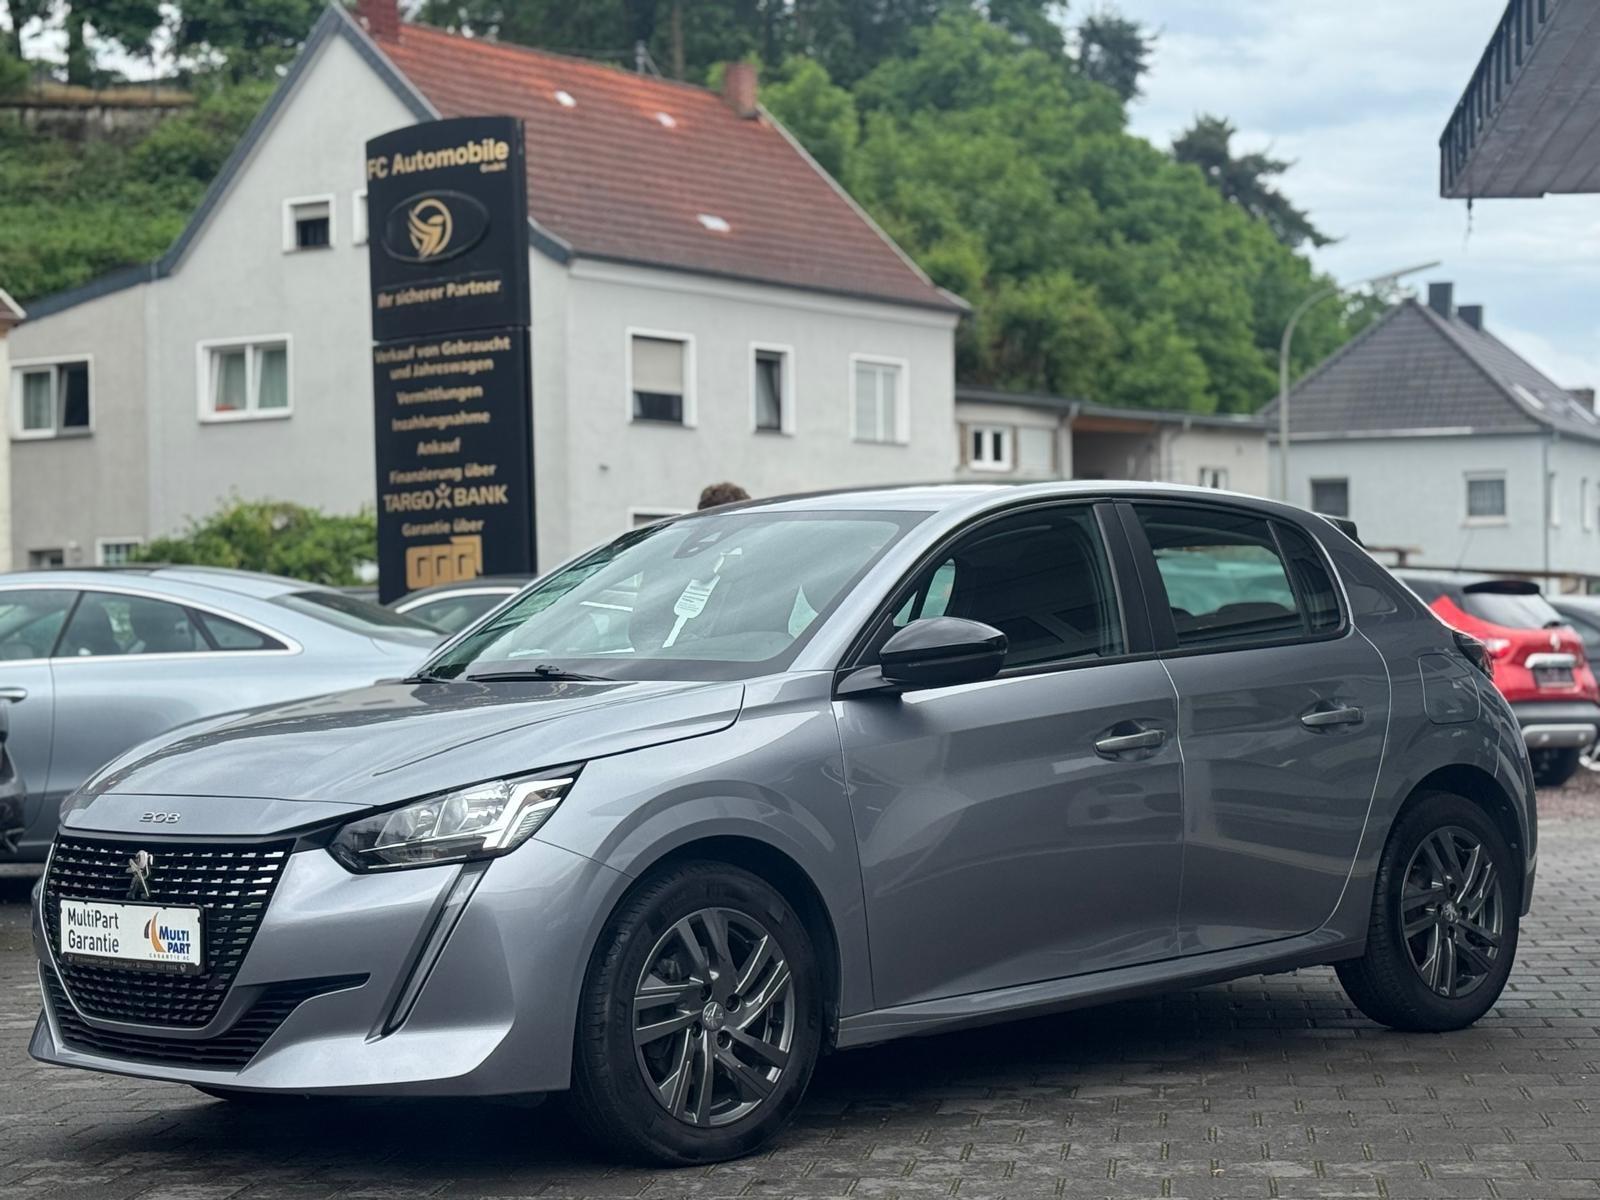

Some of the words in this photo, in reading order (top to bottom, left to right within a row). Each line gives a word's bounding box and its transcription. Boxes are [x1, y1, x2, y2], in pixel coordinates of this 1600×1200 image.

[367, 156, 388, 180] FC
[391, 138, 509, 175] Automobile
[377, 292, 394, 308] Ihr
[395, 287, 444, 306] sicherer
[446, 280, 501, 298] Partner
[374, 345, 415, 363] Verkauf
[416, 345, 440, 358] von
[440, 336, 510, 355] Gebraucht
[390, 363, 412, 380] und
[412, 358, 493, 377] Jahreswagen
[396, 385, 483, 405] Vermittlungen
[391, 411, 490, 431] Inzahlungnahme
[416, 437, 461, 455] Ankauf
[389, 466, 463, 484] Finanzierung
[464, 462, 497, 478] über
[383, 490, 435, 512] TARGO
[453, 484, 508, 507] BANK
[402, 521, 451, 537] Garantie
[452, 518, 484, 533] über
[139, 811, 181, 824] 208
[67, 907, 120, 930] MultiPart
[68, 929, 120, 953] Garantie
[167, 942, 191, 955] PART
